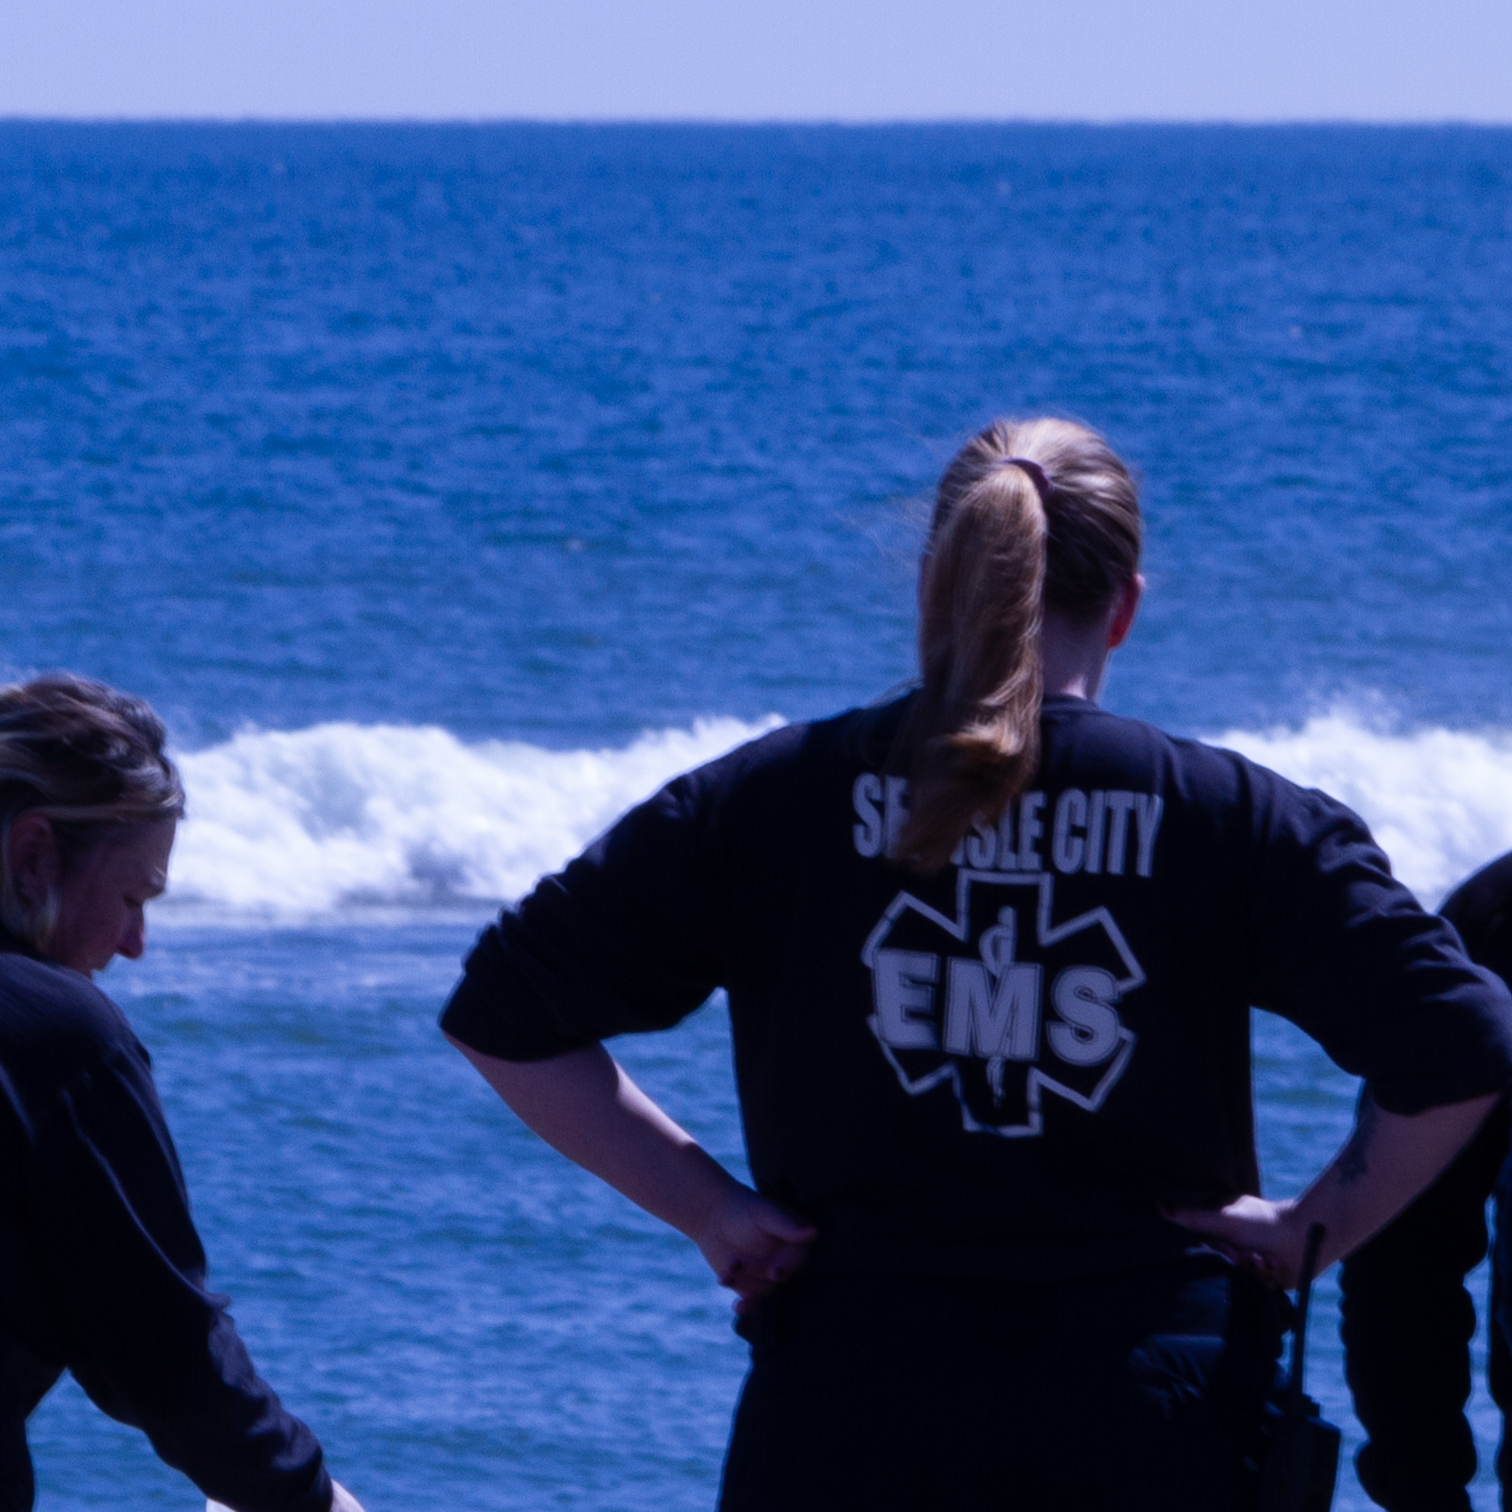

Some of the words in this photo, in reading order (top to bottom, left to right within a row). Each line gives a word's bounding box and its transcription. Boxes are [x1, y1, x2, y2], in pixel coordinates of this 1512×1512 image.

[852, 772, 919, 859] SE
[950, 790, 1047, 871] SLE
[1053, 787, 1164, 877] CITY
[872, 948, 1124, 1067] EMS
